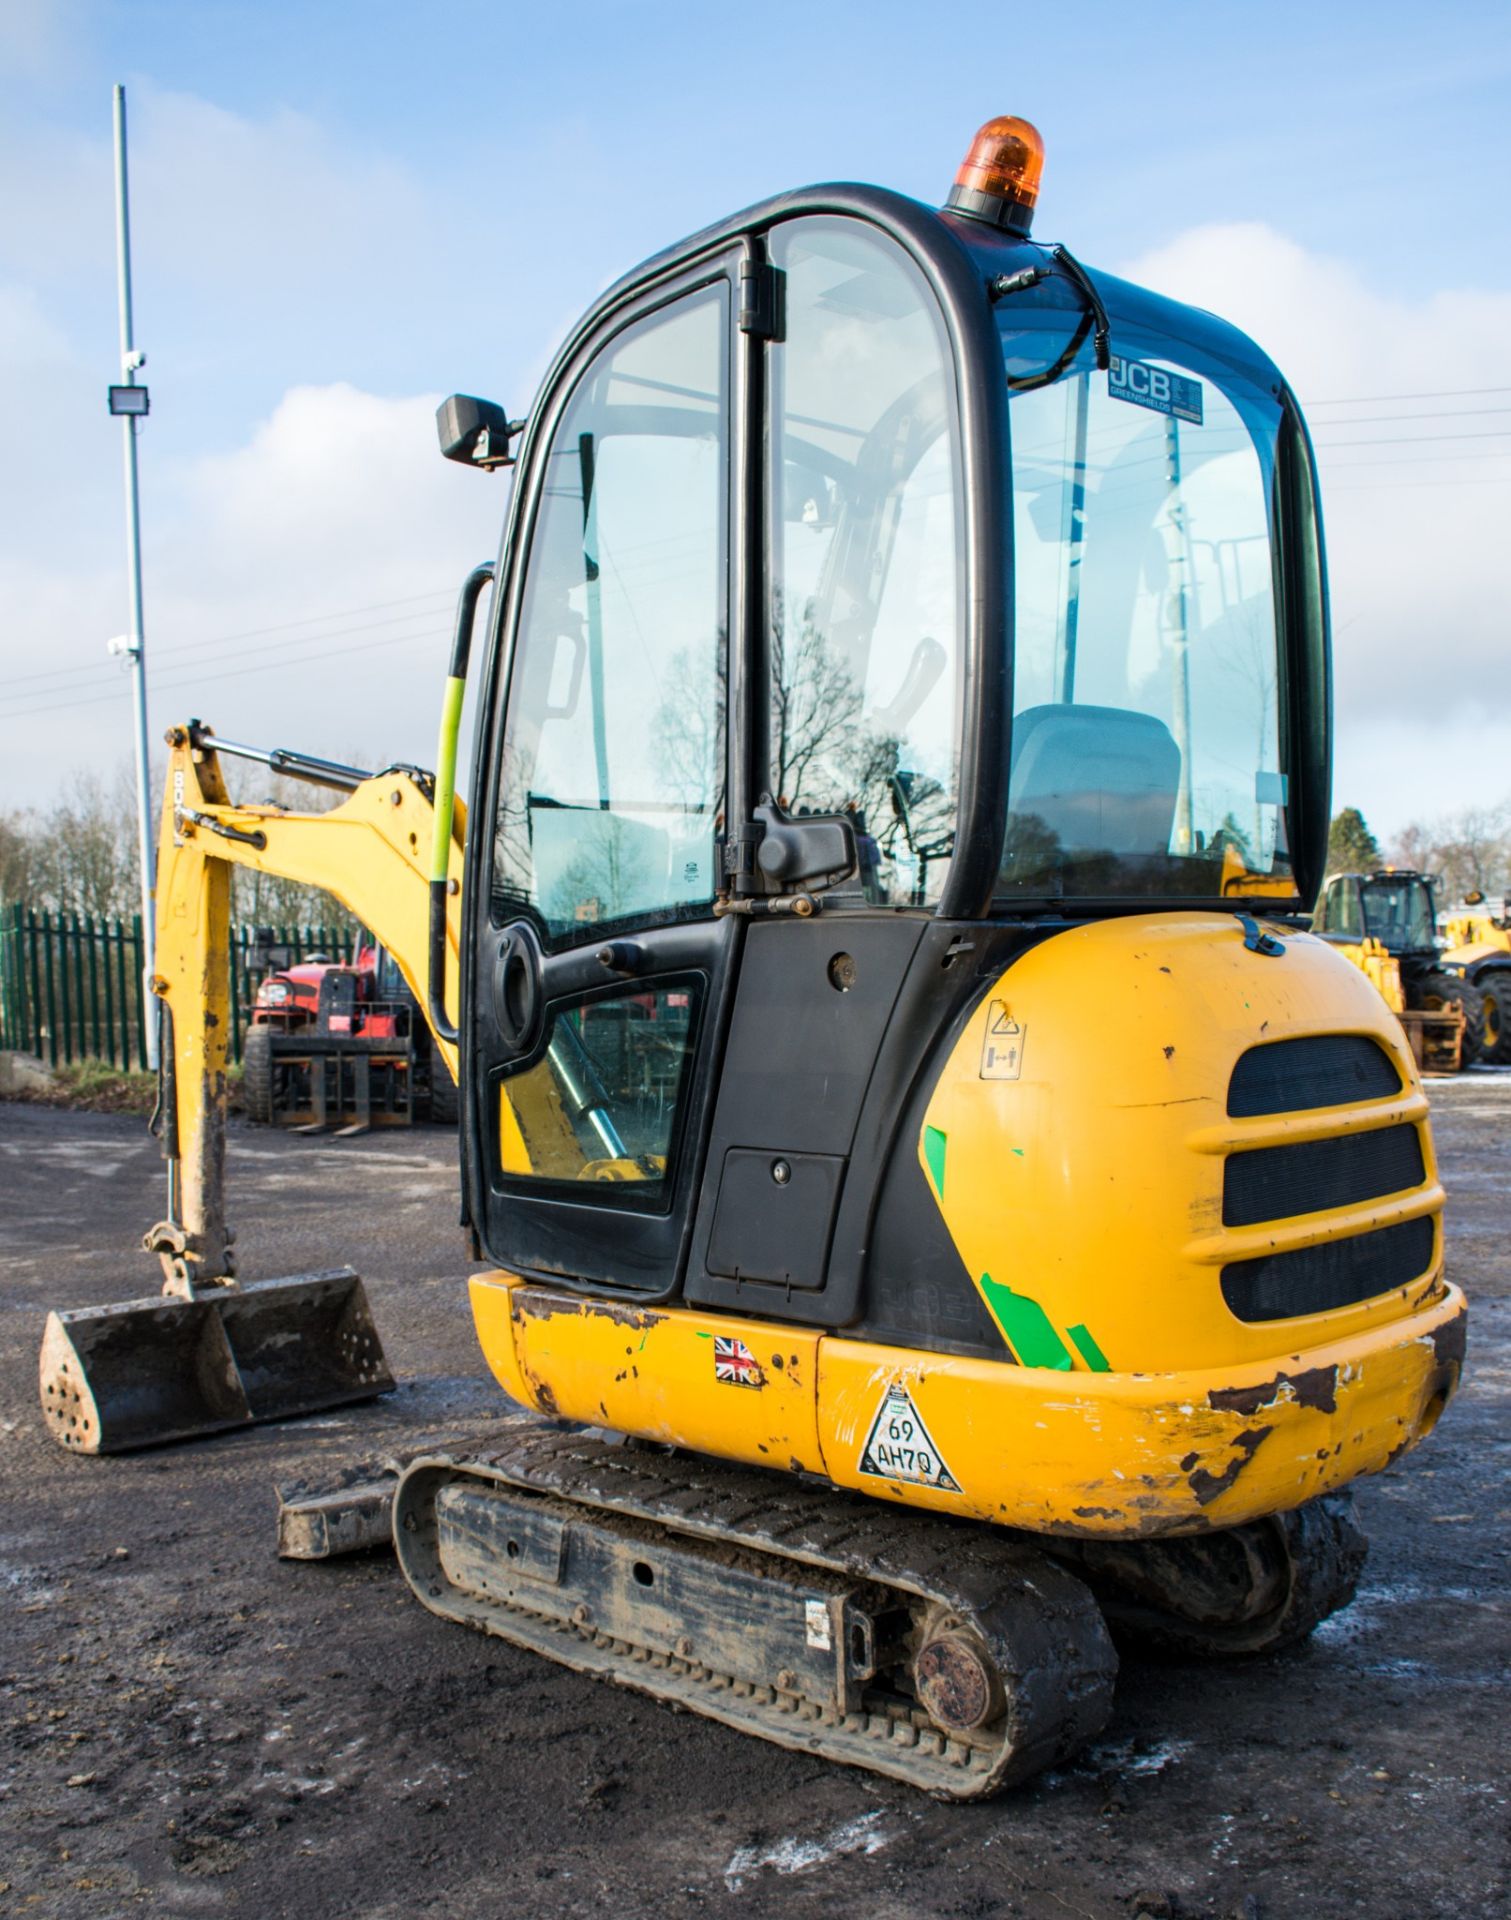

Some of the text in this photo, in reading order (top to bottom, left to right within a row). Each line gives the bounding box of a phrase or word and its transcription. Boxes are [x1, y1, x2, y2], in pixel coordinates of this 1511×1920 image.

[1110, 358, 1171, 402] JCB
[1110, 386, 1171, 412] GREENSHIELDS
[888, 1417, 914, 1442] 69
[877, 1444, 932, 1475] AH7Q
